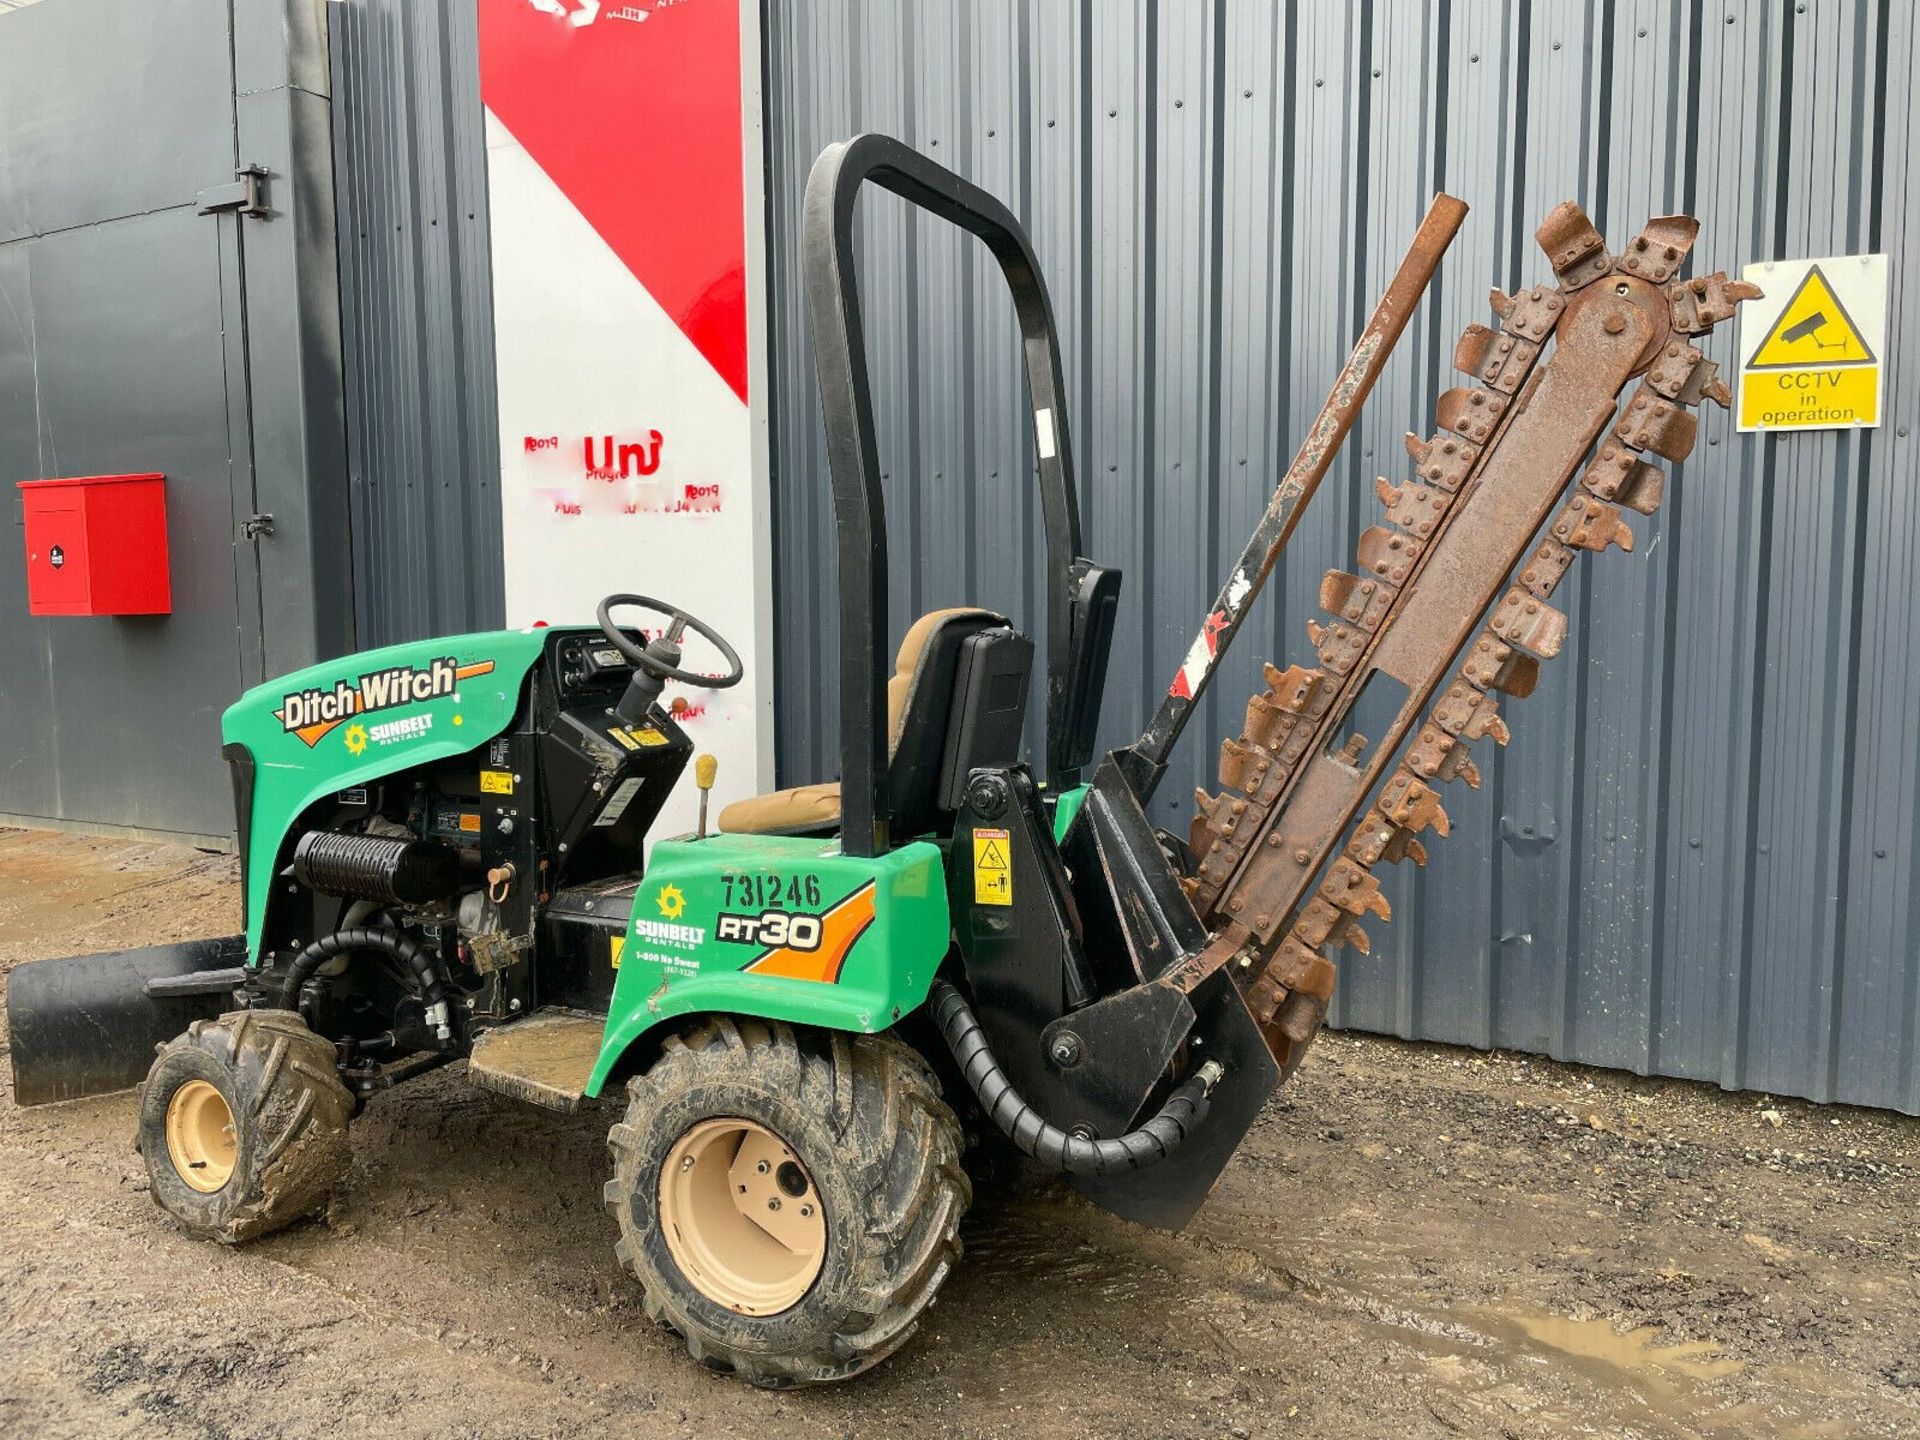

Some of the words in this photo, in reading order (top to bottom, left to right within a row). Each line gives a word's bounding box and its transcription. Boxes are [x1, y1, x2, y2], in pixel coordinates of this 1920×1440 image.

[1778, 371, 1842, 390] CCTV
[1800, 392, 1817, 405] in
[1762, 406, 1854, 425] operation
[284, 681, 355, 730] Ditch
[360, 659, 455, 710] Witch
[369, 713, 433, 741] SUNBELT
[379, 730, 426, 746] RENTALS
[720, 874, 821, 908] 731246
[635, 919, 706, 945] SUNBELT
[717, 911, 822, 950] RT30
[645, 936, 696, 950] RENTALS
[635, 951, 659, 962] 1-800
[660, 954, 673, 965] No
[674, 956, 700, 969] Sweat
